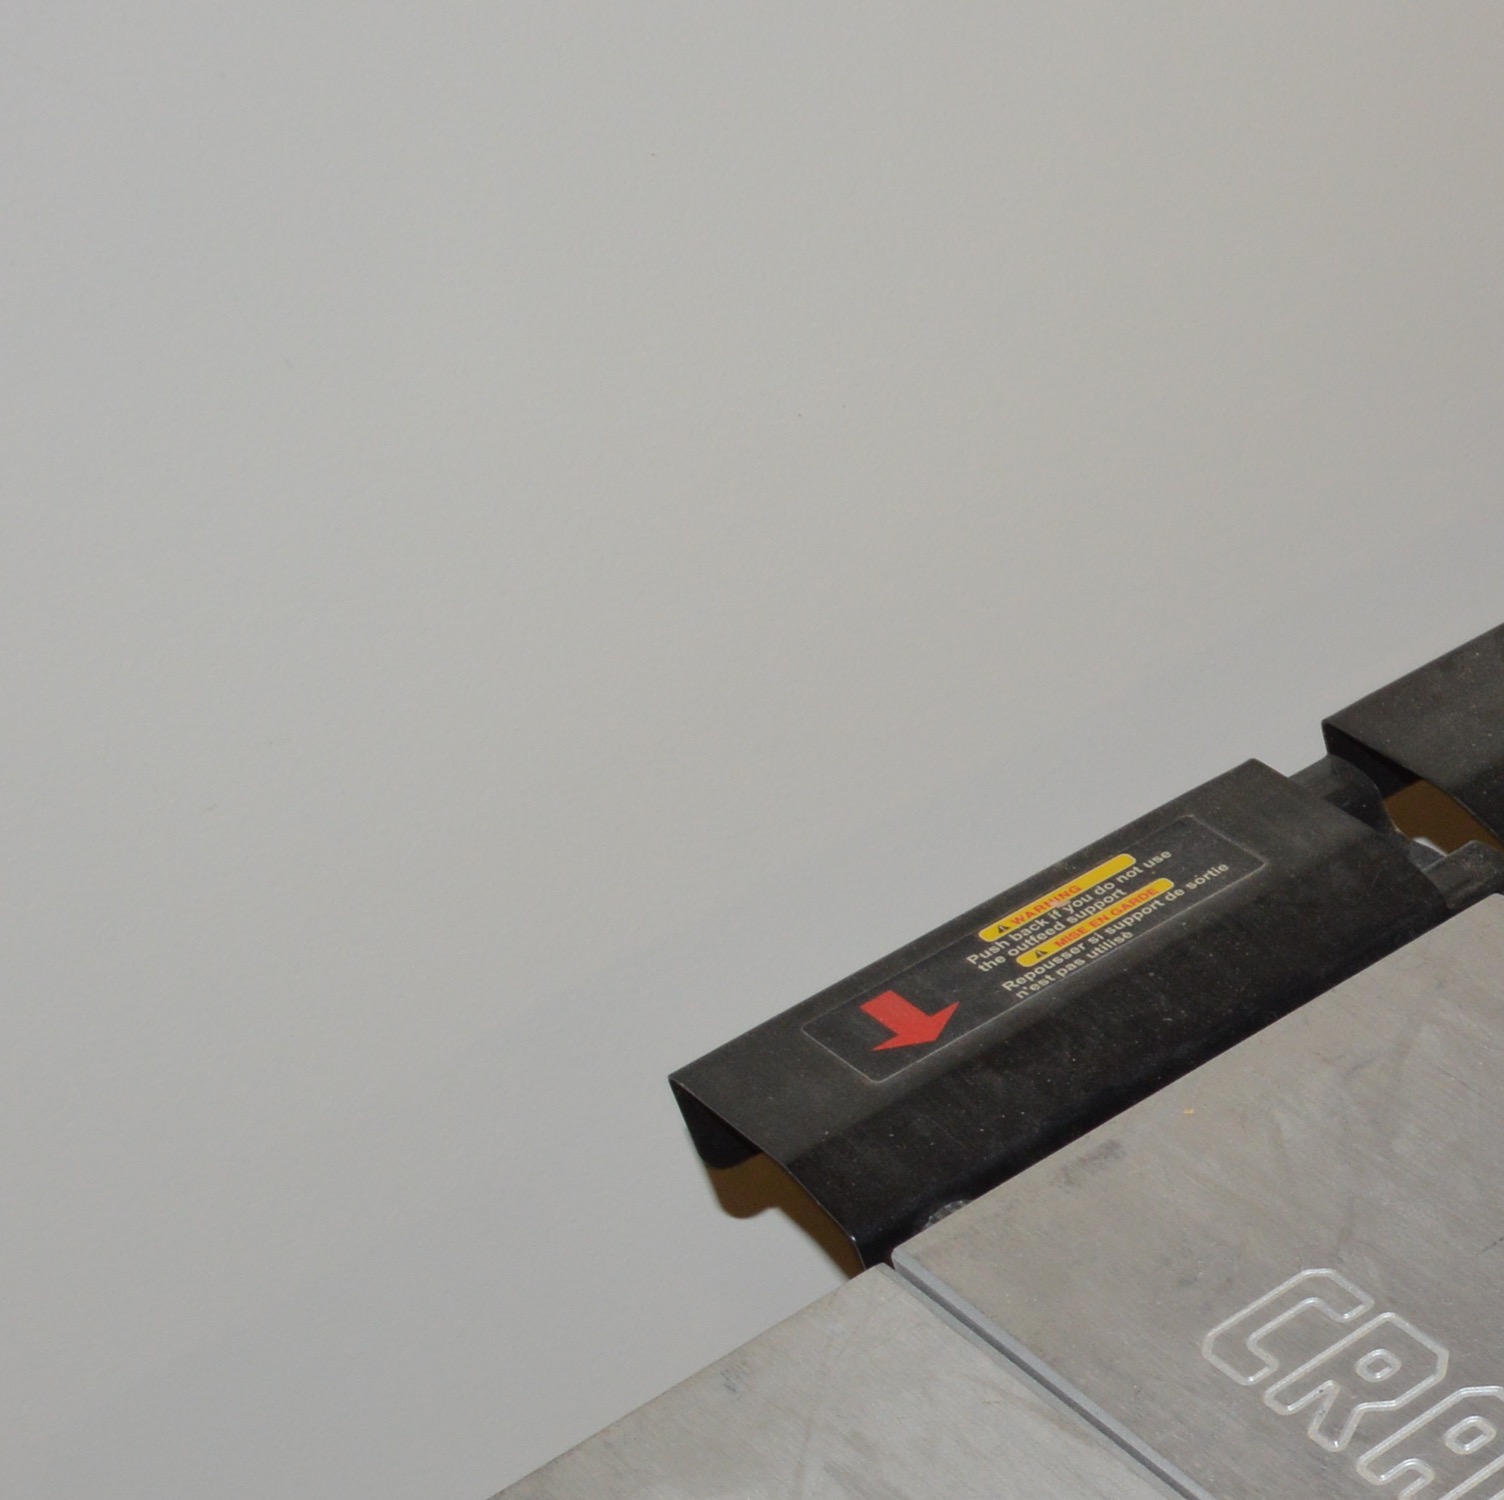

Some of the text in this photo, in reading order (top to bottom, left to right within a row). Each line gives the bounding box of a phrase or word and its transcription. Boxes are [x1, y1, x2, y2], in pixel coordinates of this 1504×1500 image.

[966, 850, 1173, 966] Push back if you do not use
[978, 888, 1128, 974] the outfeed support
[1001, 941, 1093, 992] Repousser
[1090, 932, 1105, 945] si
[1104, 899, 1166, 937] support
[1164, 886, 1185, 902] de
[1010, 884, 1083, 926] WARNING
[1054, 886, 1162, 949] MISE EN GARDE
[1015, 978, 1055, 1000] n'est
[1056, 958, 1086, 978] pas
